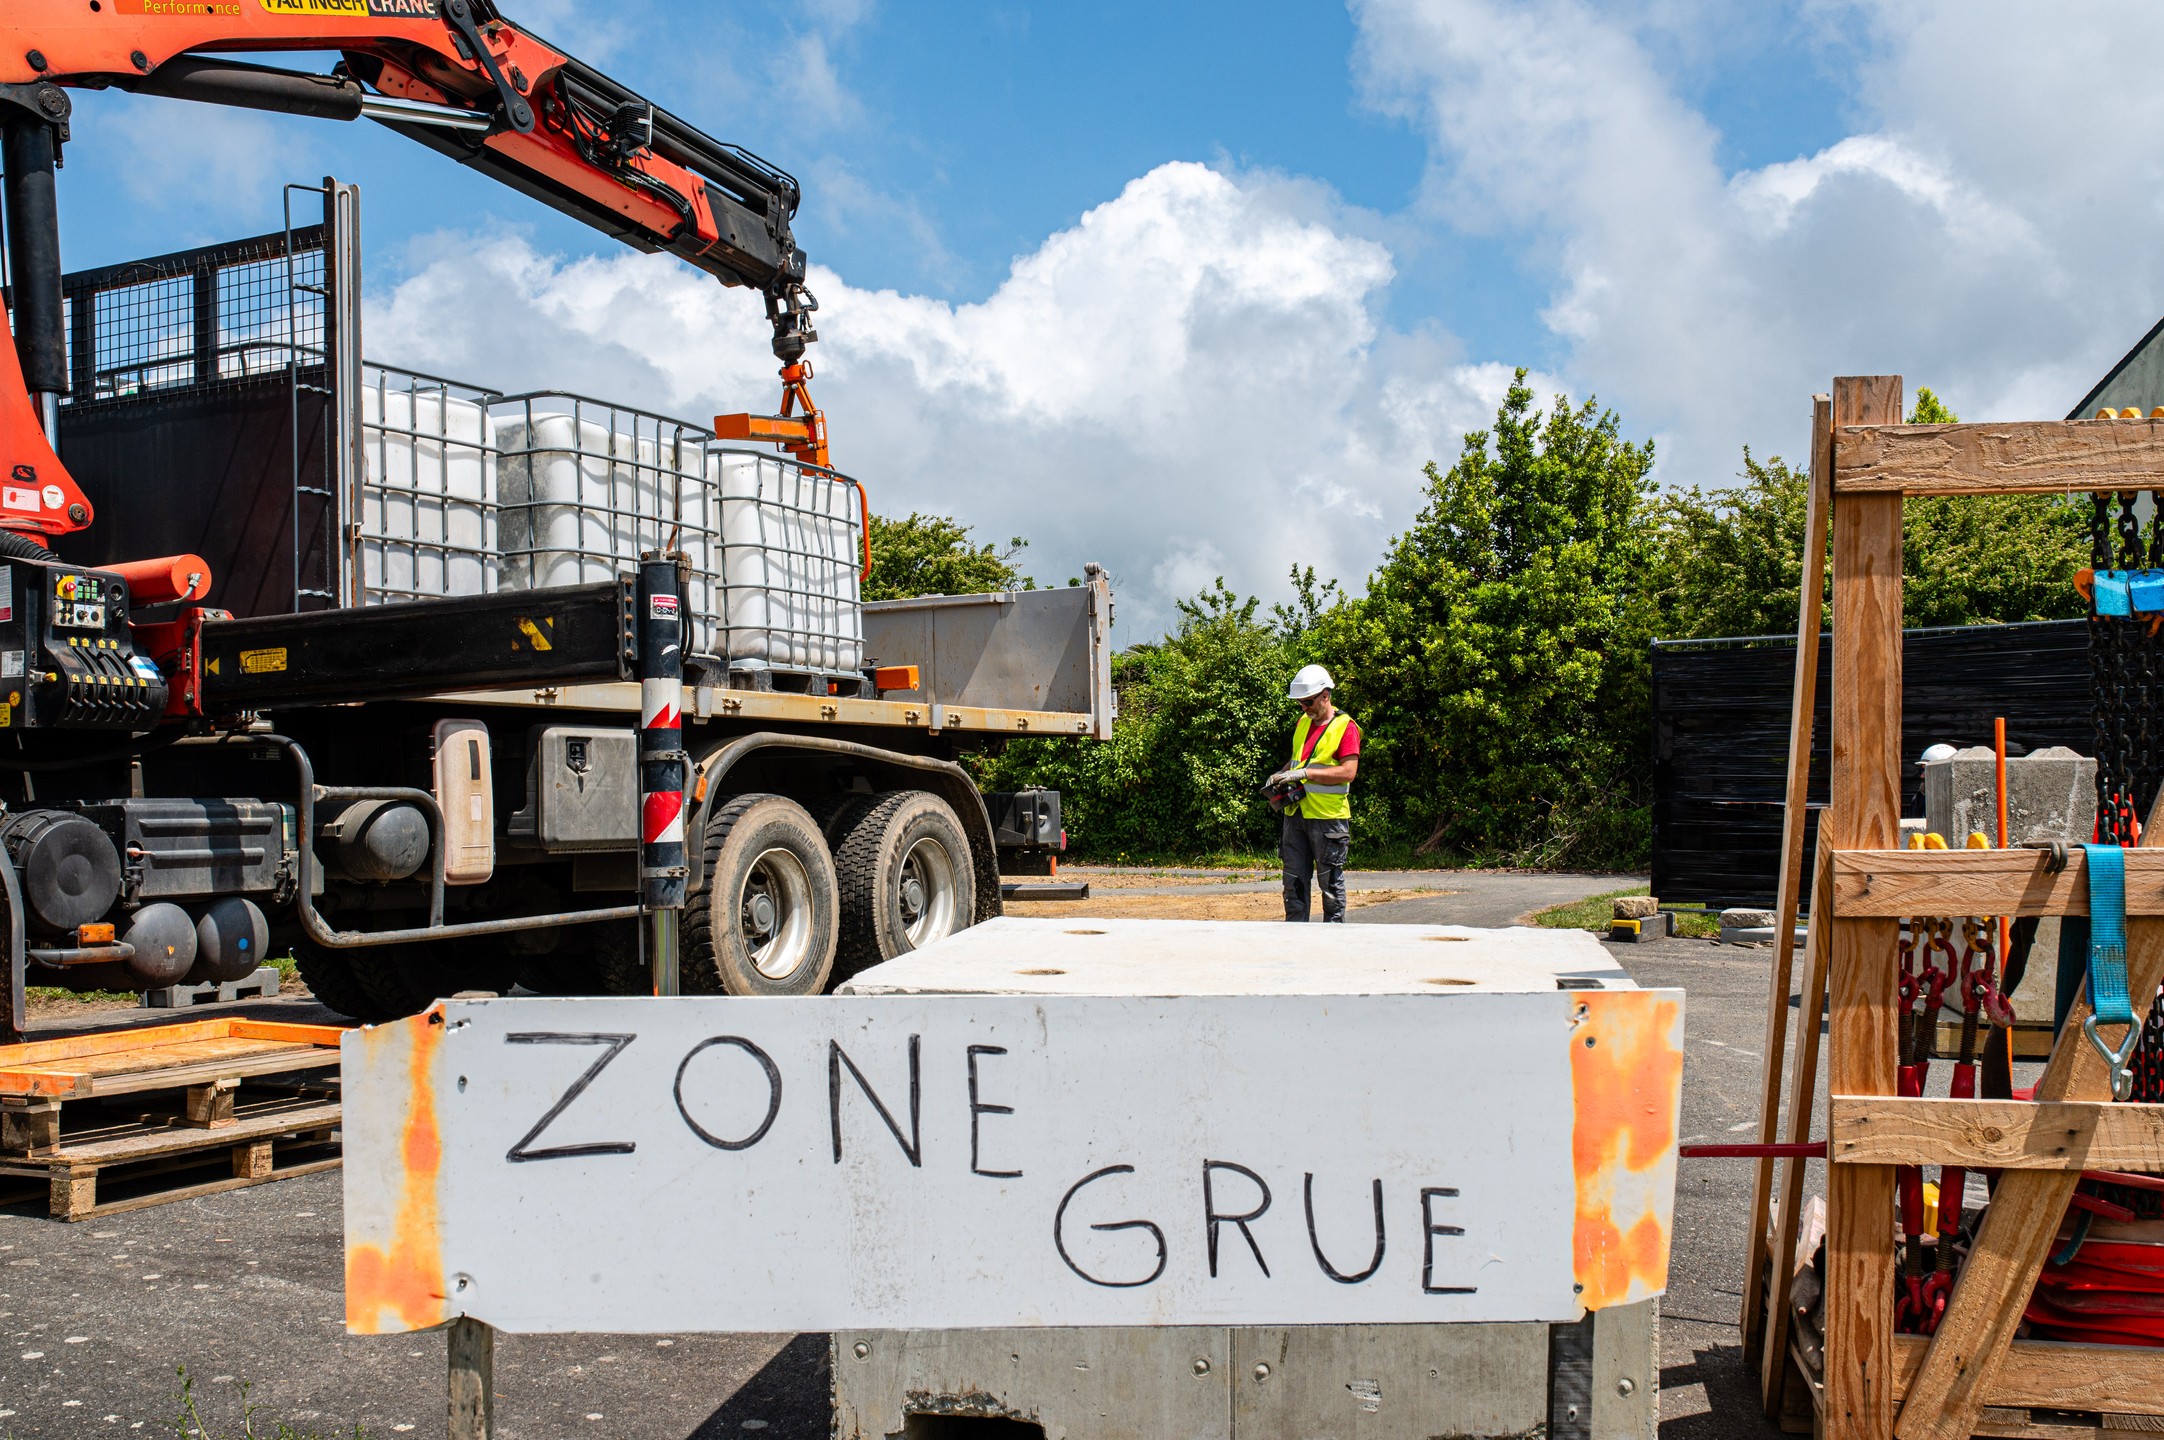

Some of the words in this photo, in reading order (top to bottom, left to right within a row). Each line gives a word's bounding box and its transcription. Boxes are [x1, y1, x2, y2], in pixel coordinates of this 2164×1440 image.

[143, 0, 240, 14] Performnce
[775, 822, 817, 849] MICHELIN
[505, 1032, 1025, 1180] ZONE
[1053, 1158, 1479, 1296] GRUE
